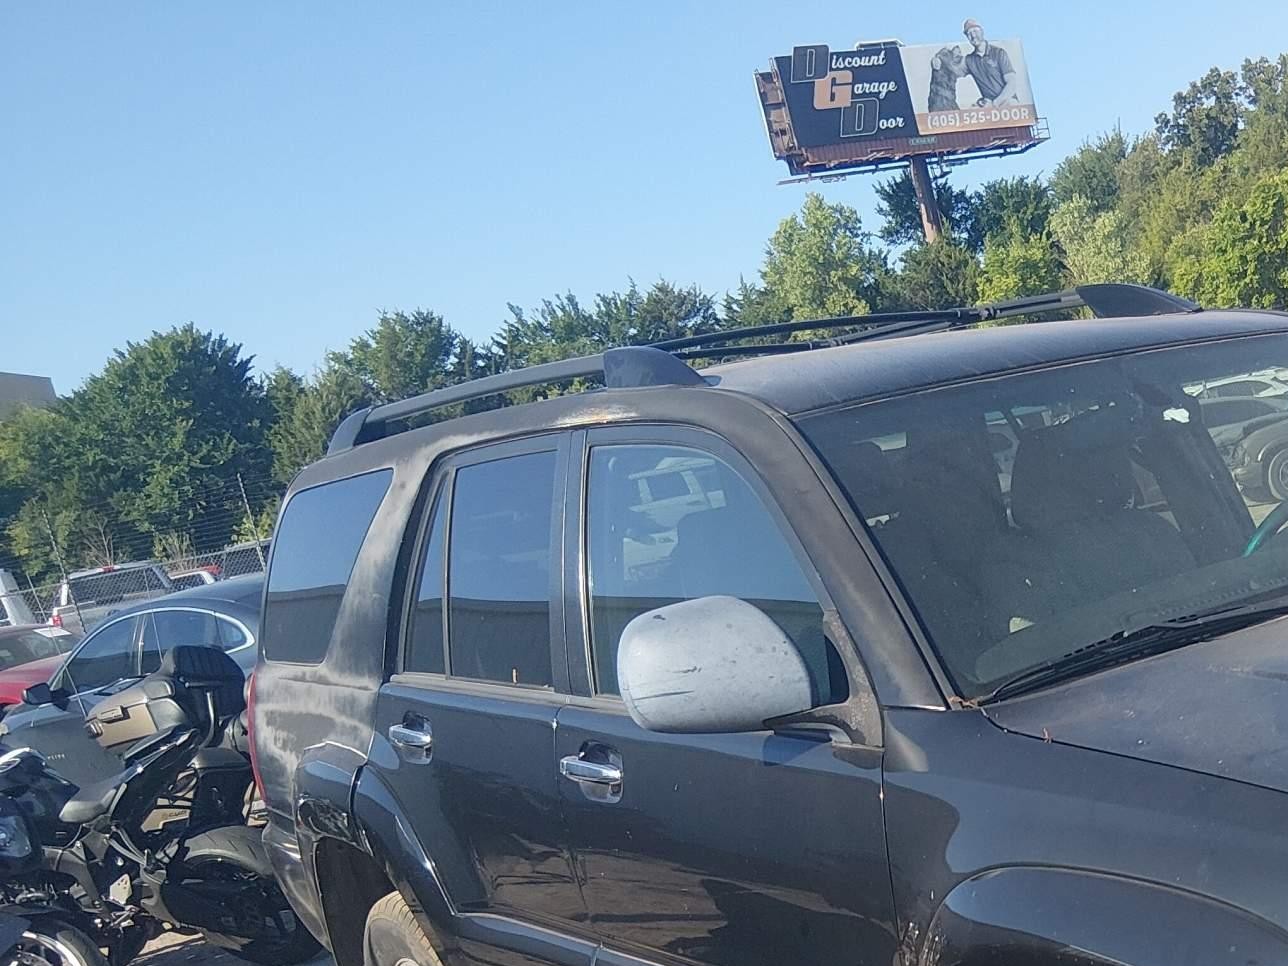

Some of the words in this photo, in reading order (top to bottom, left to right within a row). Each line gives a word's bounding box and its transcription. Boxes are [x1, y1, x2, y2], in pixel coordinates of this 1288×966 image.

[791, 44, 886, 83] Discount
[814, 70, 898, 110] Garage
[840, 97, 905, 138] Door
[927, 113, 960, 129] (405)
[962, 107, 1030, 125] 525-DOOR
